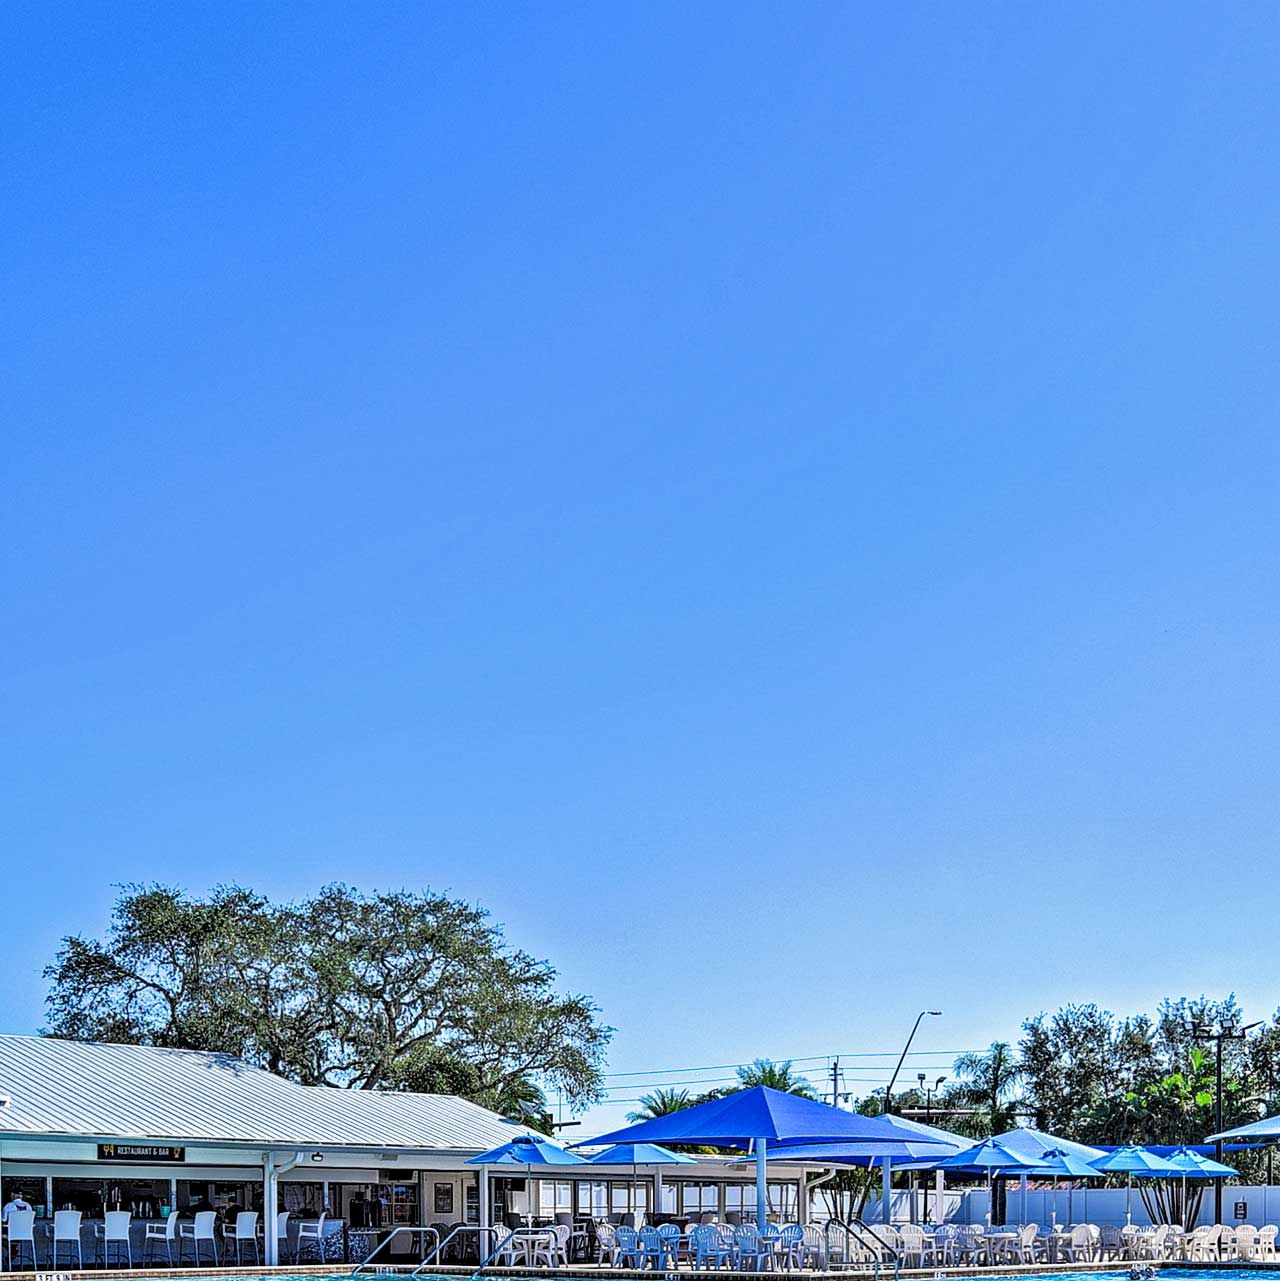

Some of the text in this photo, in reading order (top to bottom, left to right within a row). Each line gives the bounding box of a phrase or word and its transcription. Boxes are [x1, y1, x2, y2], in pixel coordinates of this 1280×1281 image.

[117, 1146, 169, 1155] RESTAURANT & BAR
